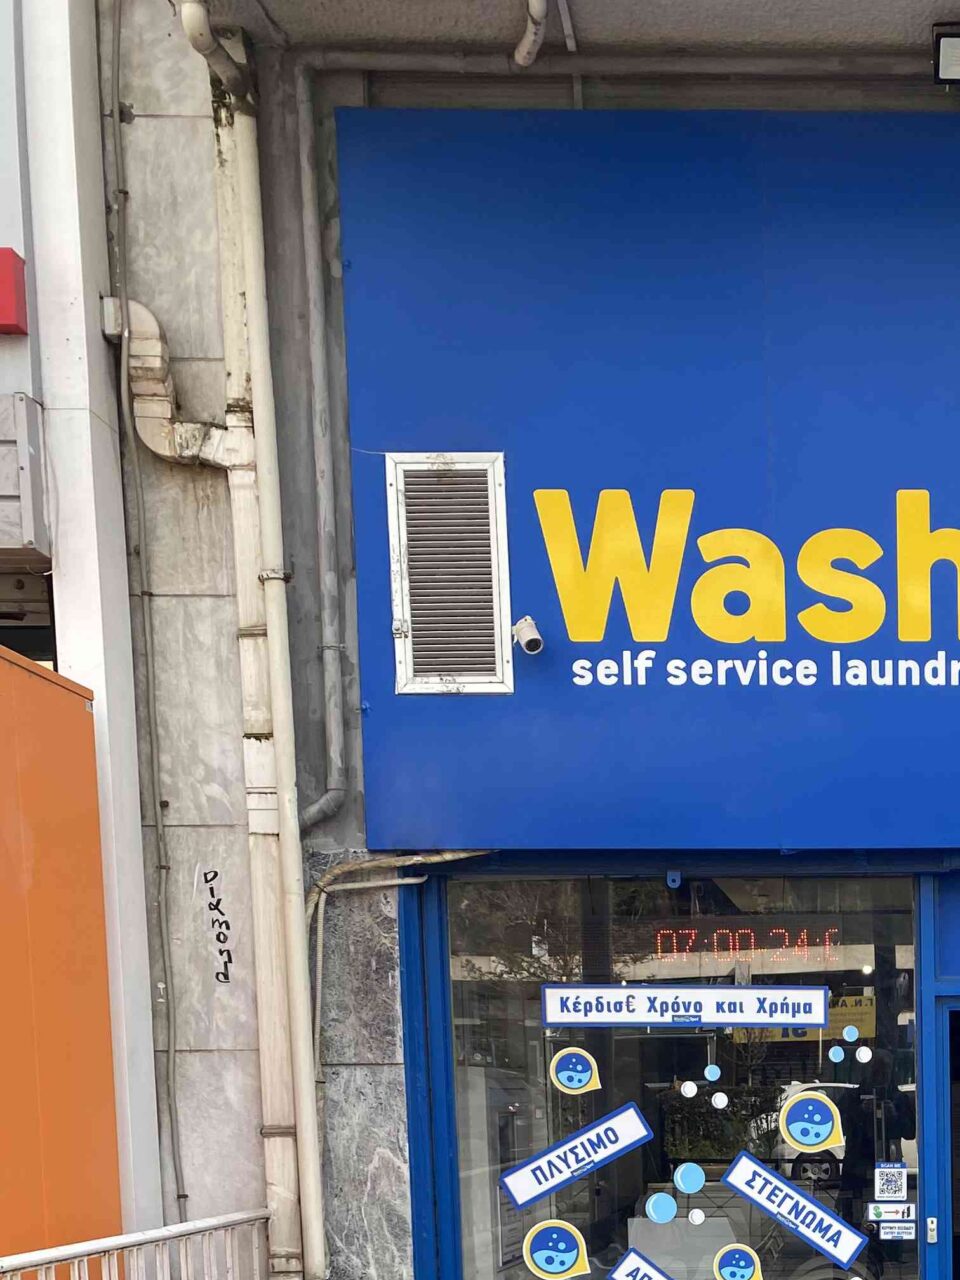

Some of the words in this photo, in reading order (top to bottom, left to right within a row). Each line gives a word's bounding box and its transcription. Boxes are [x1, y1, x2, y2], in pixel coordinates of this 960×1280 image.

[572, 649, 656, 686] self
[666, 650, 818, 686] service
[646, 995, 703, 1017] Χρόνο
[715, 1000, 744, 1014] και
[756, 996, 813, 1018] Χρήμα
[530, 1126, 619, 1186] ΠΛΥΣΙΜΟ
[745, 1170, 842, 1248] ΣΤΕΓΝΩΜΑ
